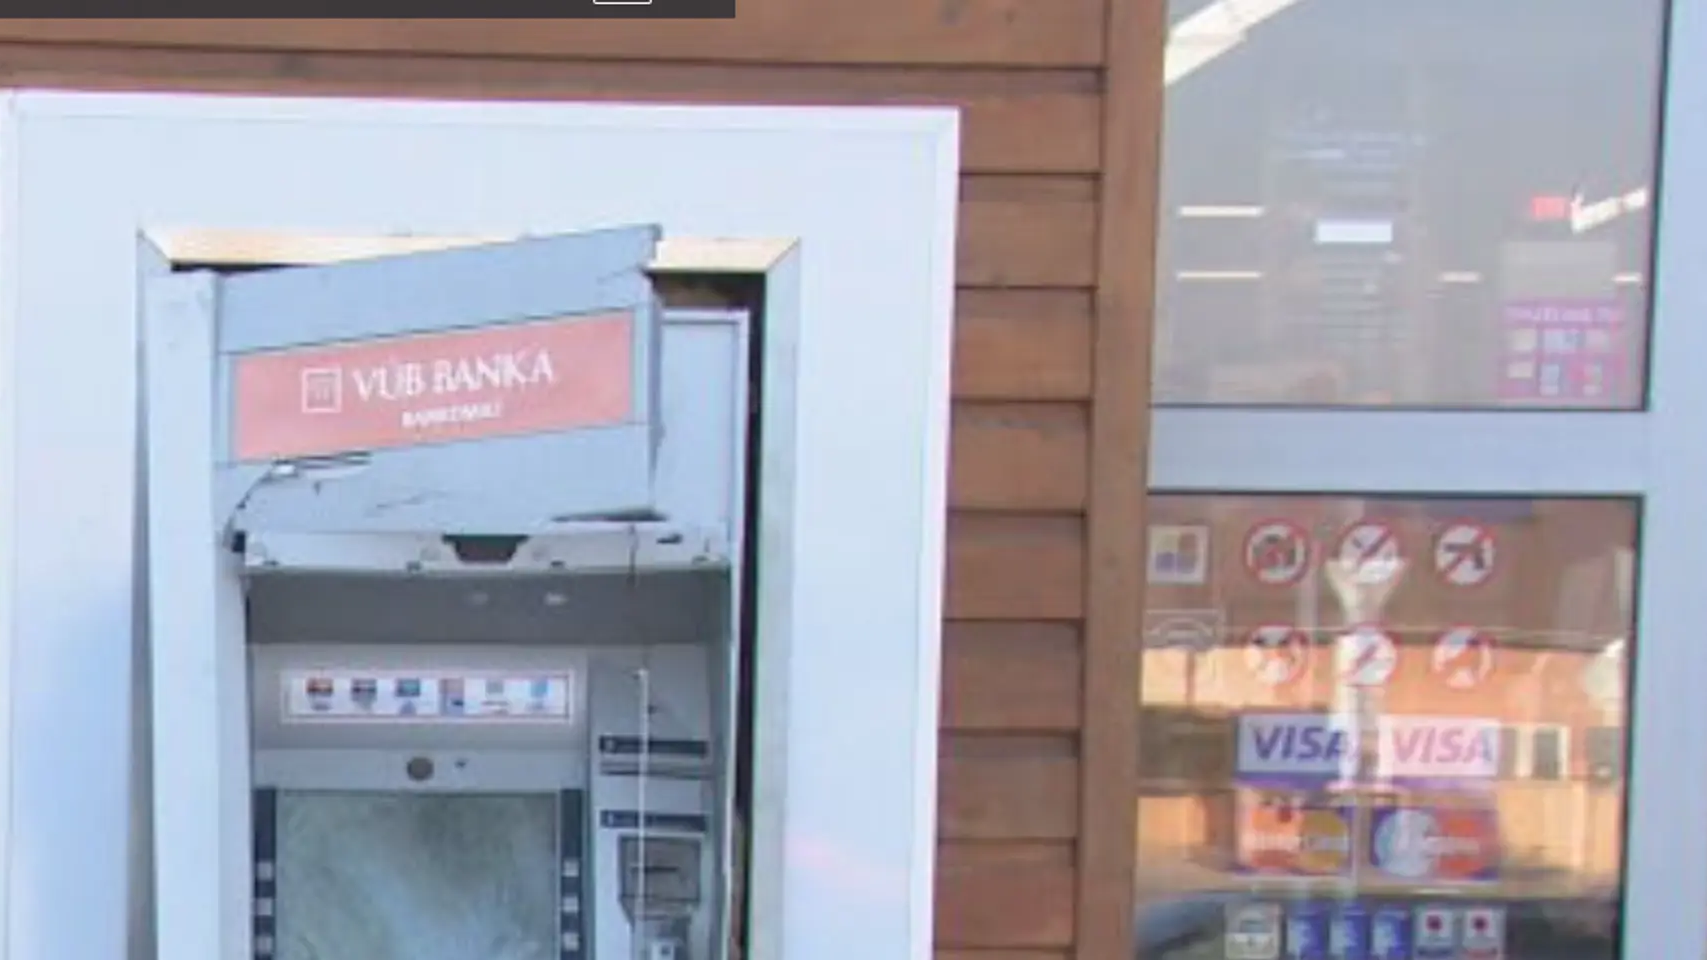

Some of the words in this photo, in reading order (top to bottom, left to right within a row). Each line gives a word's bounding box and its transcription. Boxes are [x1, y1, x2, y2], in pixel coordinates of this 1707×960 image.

[433, 348, 555, 394] BANKA
[1251, 725, 1356, 761] VISA
[1393, 726, 1495, 763] VISA
